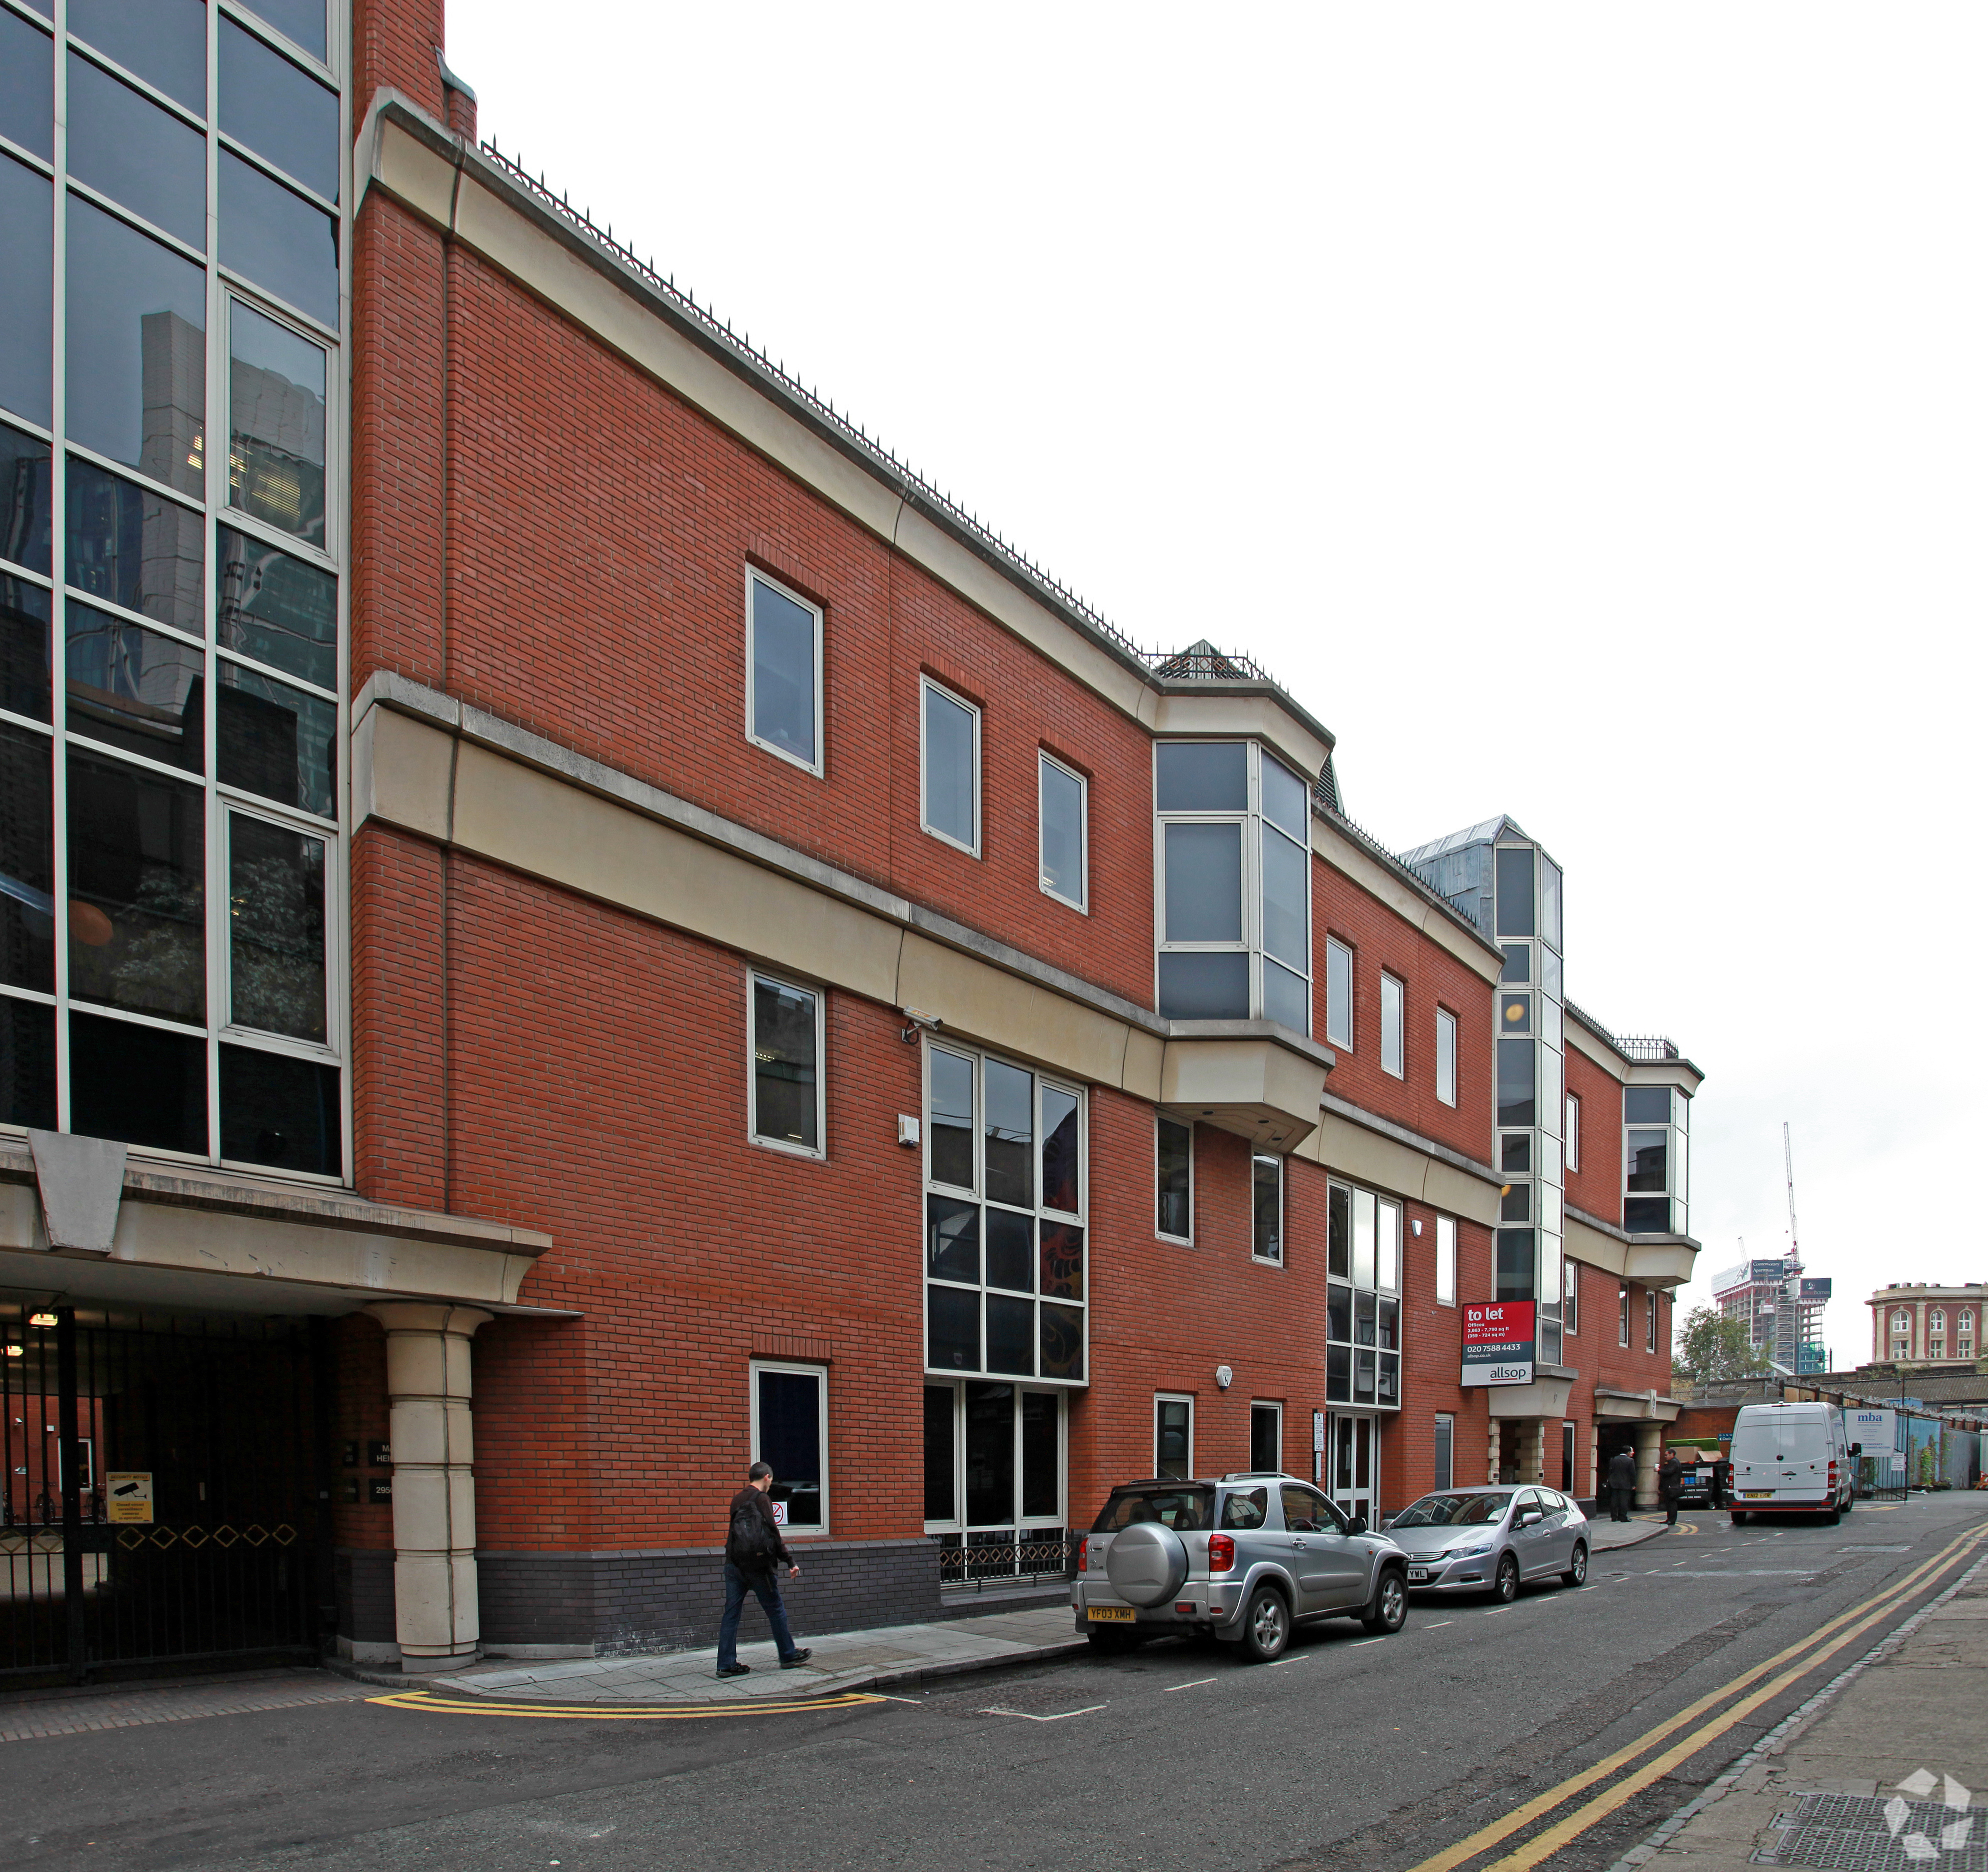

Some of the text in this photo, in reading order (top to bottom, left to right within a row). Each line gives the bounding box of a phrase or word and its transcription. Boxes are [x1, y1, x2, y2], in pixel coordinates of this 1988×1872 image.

[1468, 1307, 1504, 1321] to let
[1490, 1366, 1526, 1380] allsop
[1857, 1412, 1882, 1422] mba
[1409, 1570, 1425, 1578] YWL
[1091, 1608, 1131, 1619] YF03 XMH
